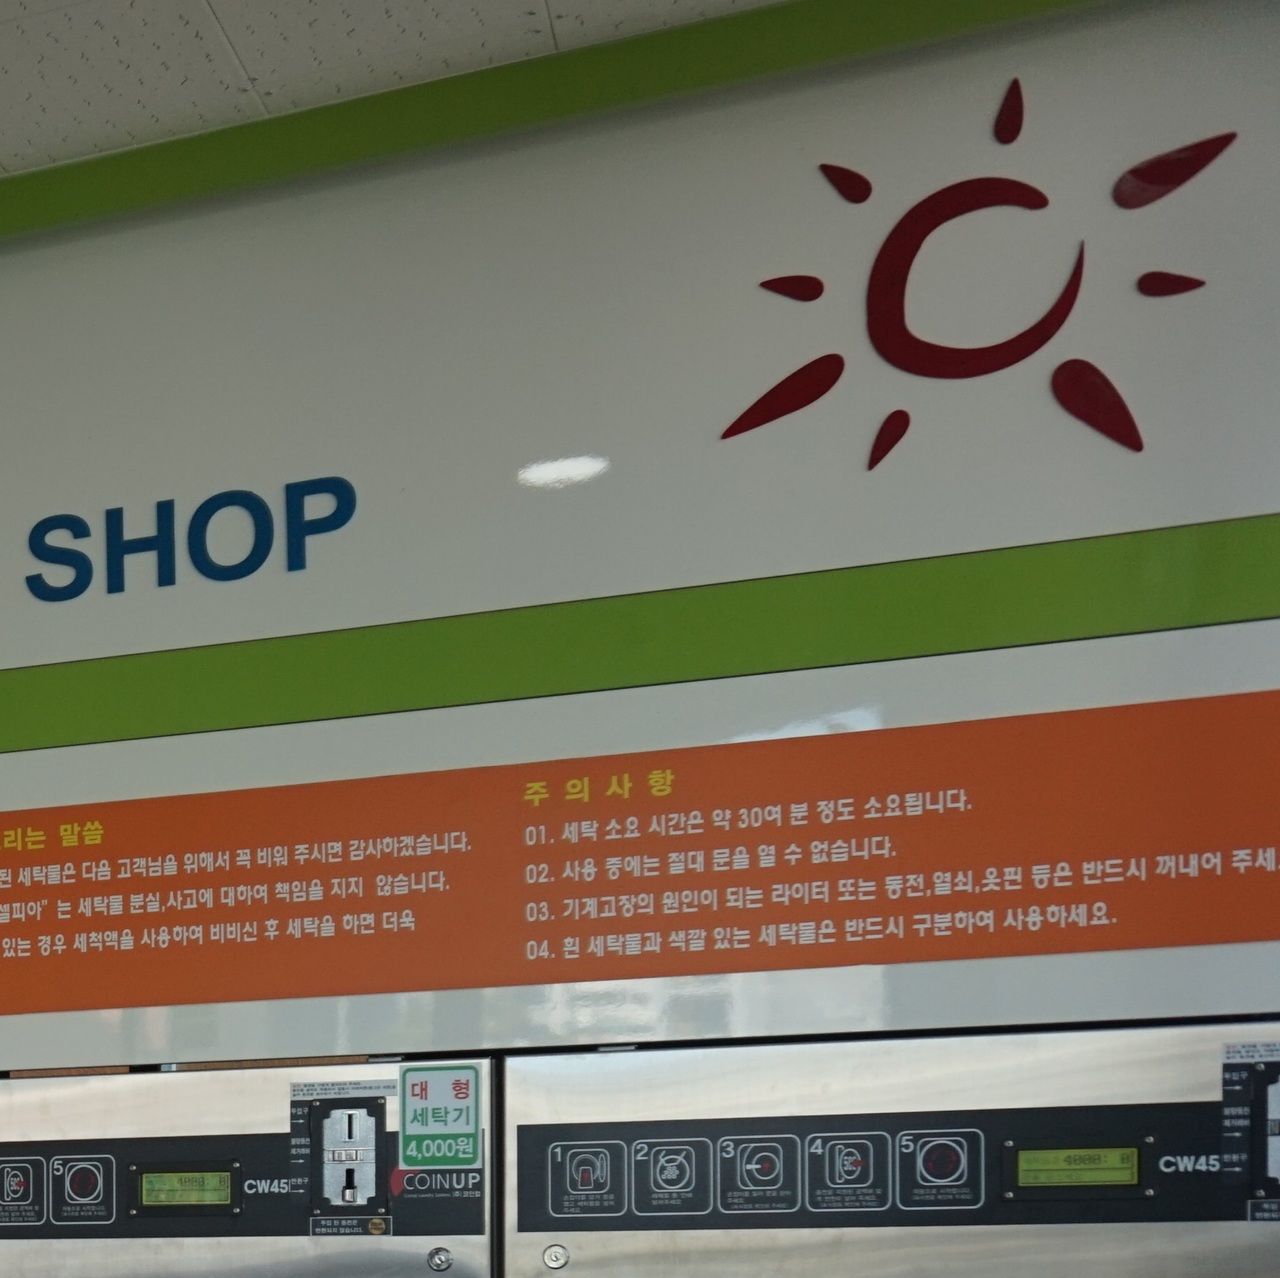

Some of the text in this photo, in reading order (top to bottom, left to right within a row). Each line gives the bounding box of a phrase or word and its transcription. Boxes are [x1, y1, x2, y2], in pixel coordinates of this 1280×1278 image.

[25, 474, 359, 603] SHOP
[524, 789, 972, 846] 01. 세탁 소요 시간은 약 30여 분 정도 소요됩니다.
[60, 821, 104, 847] 말씀
[18, 863, 75, 886] 세탁물은
[82, 860, 111, 880] 다음
[117, 854, 178, 877] 고객님을
[184, 852, 230, 872] 위해서
[237, 850, 250, 868] 꼭
[257, 846, 288, 867] 비워
[295, 841, 342, 864] 주시면
[349, 832, 471, 860] 감사하겠습니다.
[526, 836, 895, 884] 02. 사용 중에는 절대 문을 열 수 없습니다.
[57, 900, 71, 919] 는
[78, 894, 123, 915] 세탁물
[220, 884, 267, 907] 대하여
[275, 880, 323, 902] 책임을
[331, 876, 363, 898] 지지
[376, 871, 450, 896] 않습니다.
[526, 902, 554, 921] 03.
[564, 893, 654, 920] 기계고장의
[663, 889, 718, 914] 원인이
[726, 886, 763, 909] 되는
[772, 881, 829, 905] 라이터
[838, 876, 876, 901] 또는
[1032, 862, 1072, 889] 등은
[1082, 857, 1146, 885] 반드시
[1155, 852, 1221, 879] 꺼내어
[1232, 847, 1280, 874] 주세
[3, 937, 31, 958] 있는
[38, 934, 66, 956] 경우
[74, 929, 133, 952] 세척액을
[141, 924, 203, 948] 사용하여
[211, 922, 257, 943] 비비신
[265, 919, 279, 940] 후
[287, 916, 335, 938] 세탁을
[343, 913, 375, 934] 하면
[383, 910, 415, 931] 더욱
[526, 901, 1117, 960] 04. 흰 세탁물과 색깔 있는 세탁물은 반드시 구분하여 사용하세요.
[411, 1081, 428, 1100] 대
[452, 1078, 470, 1100] 형
[410, 1107, 470, 1126] 세탁기
[406, 1138, 473, 1158] 4,000원
[554, 1148, 563, 1162] 1
[636, 1145, 648, 1160] 2
[722, 1141, 735, 1158] 3
[810, 1139, 823, 1155] 4
[901, 1137, 914, 1153] 5
[1158, 1154, 1220, 1173] CW45
[244, 1179, 288, 1194] CW45
